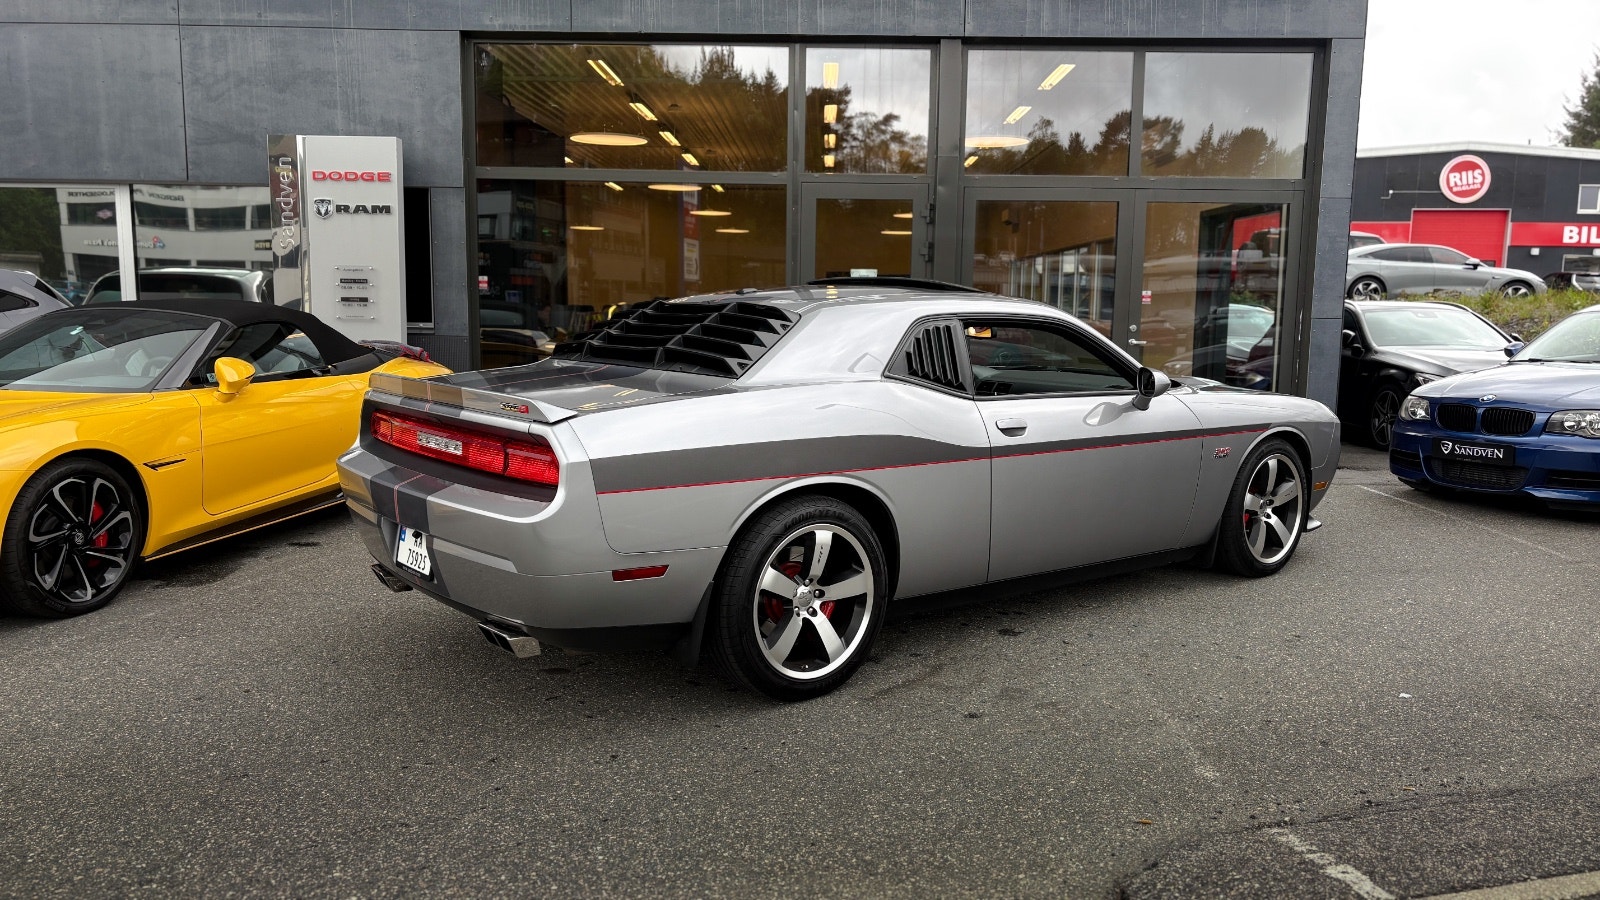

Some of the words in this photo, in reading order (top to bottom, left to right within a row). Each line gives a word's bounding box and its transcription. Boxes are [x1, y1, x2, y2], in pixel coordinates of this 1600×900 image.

[312, 171, 391, 182] DODGE
[1448, 169, 1483, 187] RIIS
[276, 157, 295, 249] Sandven
[335, 204, 391, 214] RAM
[1562, 225, 1600, 244] BIL
[1454, 444, 1504, 459] SANDVEN
[406, 547, 427, 571] 75925
